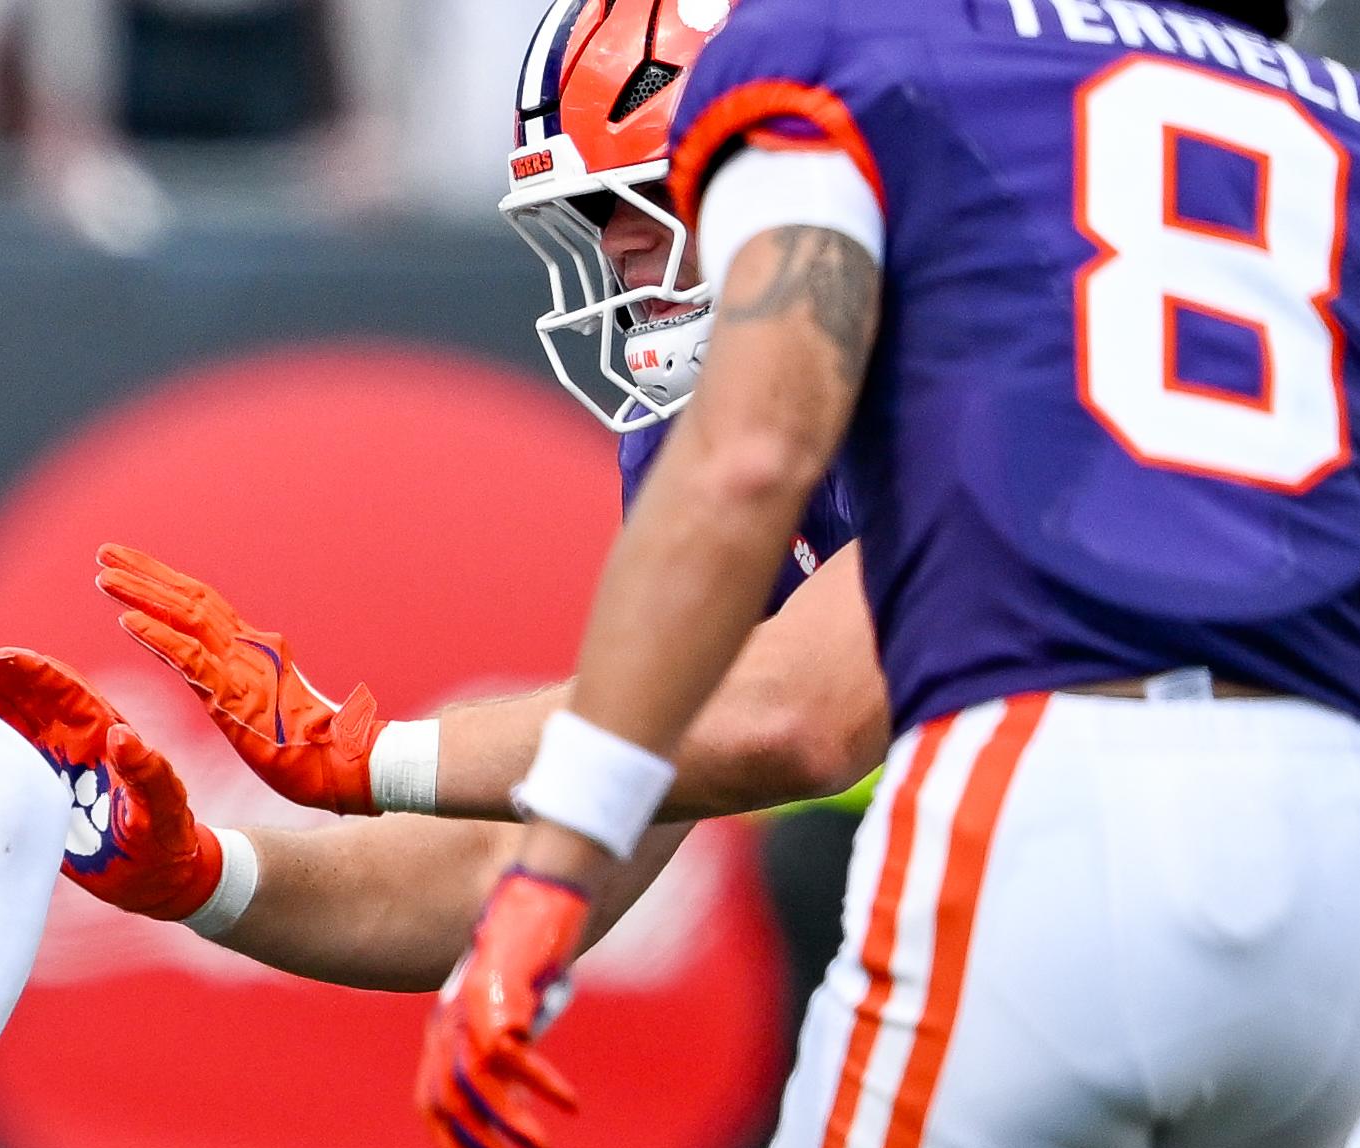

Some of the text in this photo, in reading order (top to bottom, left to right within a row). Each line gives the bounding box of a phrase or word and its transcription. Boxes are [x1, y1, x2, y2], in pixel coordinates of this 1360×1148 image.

[510, 149, 554, 180] TIGERS
[1074, 53, 1353, 496] 8
[643, 349, 659, 368] IN
